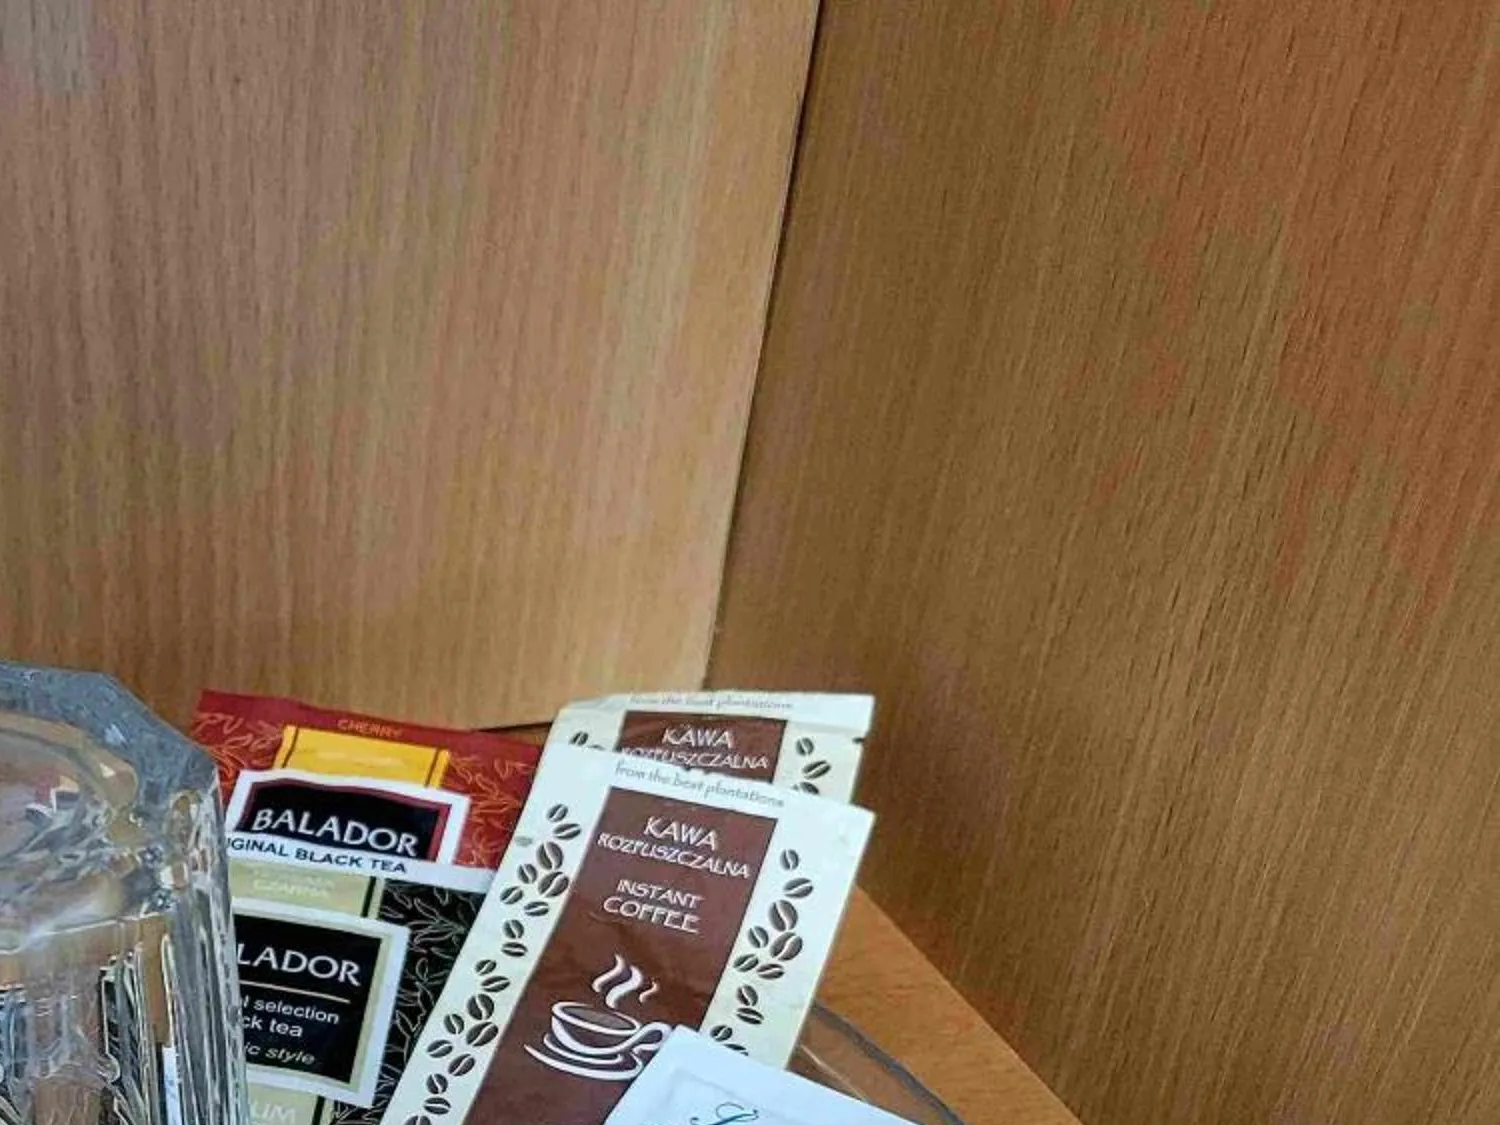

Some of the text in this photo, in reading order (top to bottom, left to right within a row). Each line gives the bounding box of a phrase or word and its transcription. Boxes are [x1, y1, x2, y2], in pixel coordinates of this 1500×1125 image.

[661, 726, 734, 749] KAWA
[615, 760, 647, 781] from
[648, 767, 671, 785] the
[705, 780, 785, 808] plantations
[251, 807, 420, 857] BALADOR
[643, 815, 719, 850] KAWA
[227, 836, 408, 874] IGINAL BLACK TEA
[597, 832, 750, 879] ROZPUSZCZALNA
[616, 879, 705, 910] INSTANT
[603, 896, 701, 935] COFFEE
[237, 943, 360, 987] LADOR
[253, 998, 339, 1024] selection
[269, 1018, 304, 1037] tea
[265, 1047, 315, 1065] style
